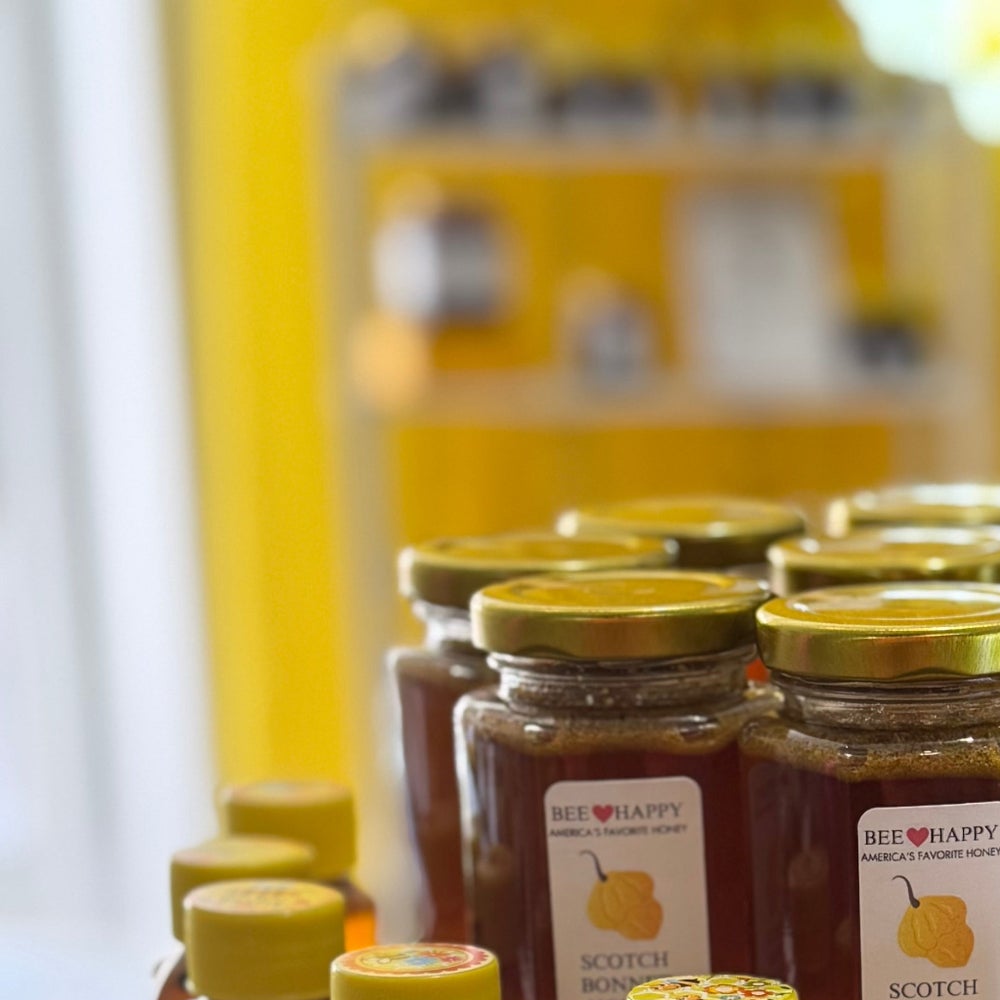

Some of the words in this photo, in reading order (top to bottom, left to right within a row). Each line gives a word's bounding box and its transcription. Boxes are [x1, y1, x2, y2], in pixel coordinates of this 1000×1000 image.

[551, 805, 590, 821] BEE
[614, 802, 683, 820] HAPPY
[864, 829, 904, 845] BEE
[929, 824, 998, 844] HAPPY
[861, 850, 916, 862] AMERICA'S
[918, 848, 964, 861] FAVORITE
[581, 951, 669, 971] SCOTCH
[889, 979, 978, 999] SCOTCH
